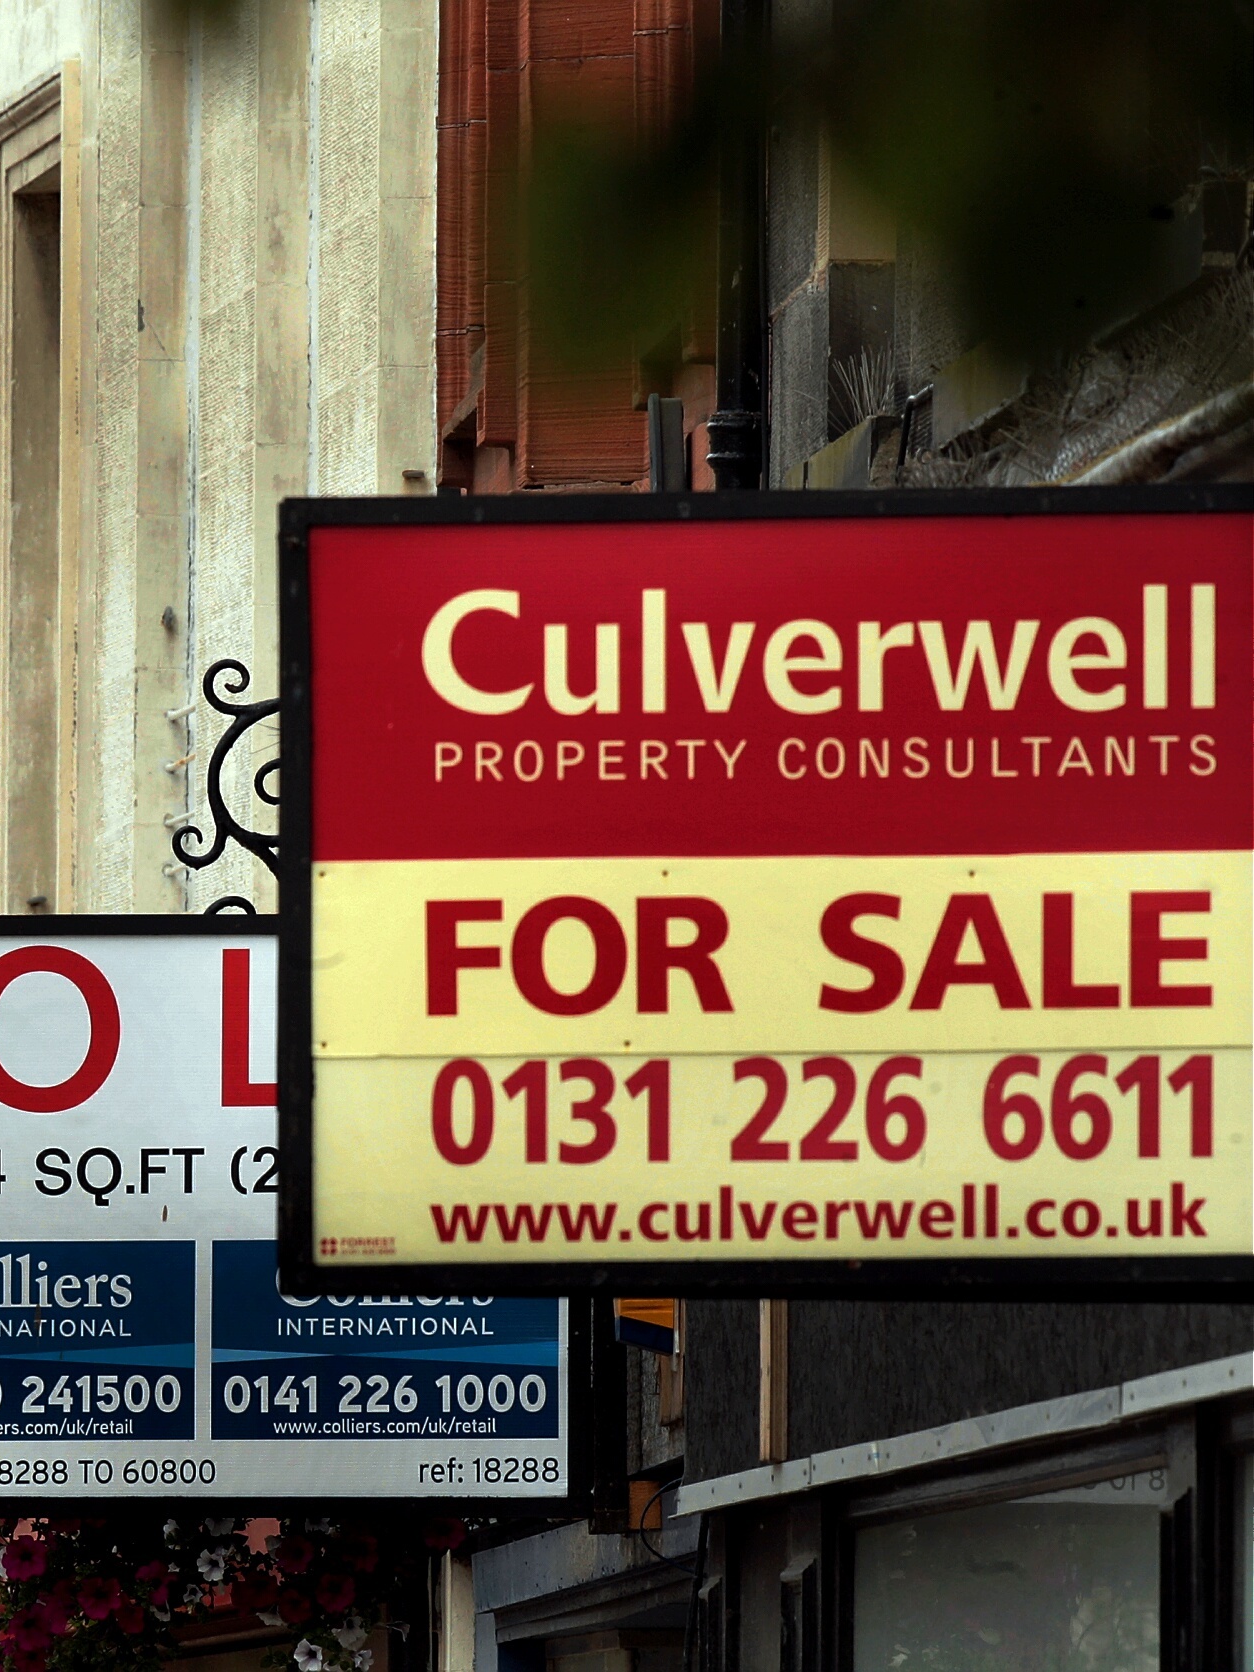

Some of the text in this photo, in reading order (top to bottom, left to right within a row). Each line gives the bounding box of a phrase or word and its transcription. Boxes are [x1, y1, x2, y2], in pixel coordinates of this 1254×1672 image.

[422, 584, 1215, 715] Culverwell
[435, 735, 1216, 781] PROPERTY CONSULTANTS
[426, 891, 1212, 1016] FOR SALE
[432, 1053, 1212, 1165] 0131 226 6611
[34, 1147, 205, 1206] SQ.FT
[430, 1183, 1206, 1243] www.culverwell.co.uk
[279, 1318, 493, 1335] INTERNATIONAL
[22, 1375, 180, 1413] 241500
[224, 1375, 546, 1413] 0141 226 1000
[274, 1417, 496, 1434] www.colliers.com/uk/retail
[78, 1459, 113, 1484] TO
[122, 1460, 216, 1483] 60800
[420, 1457, 559, 1483] ref: 18288
